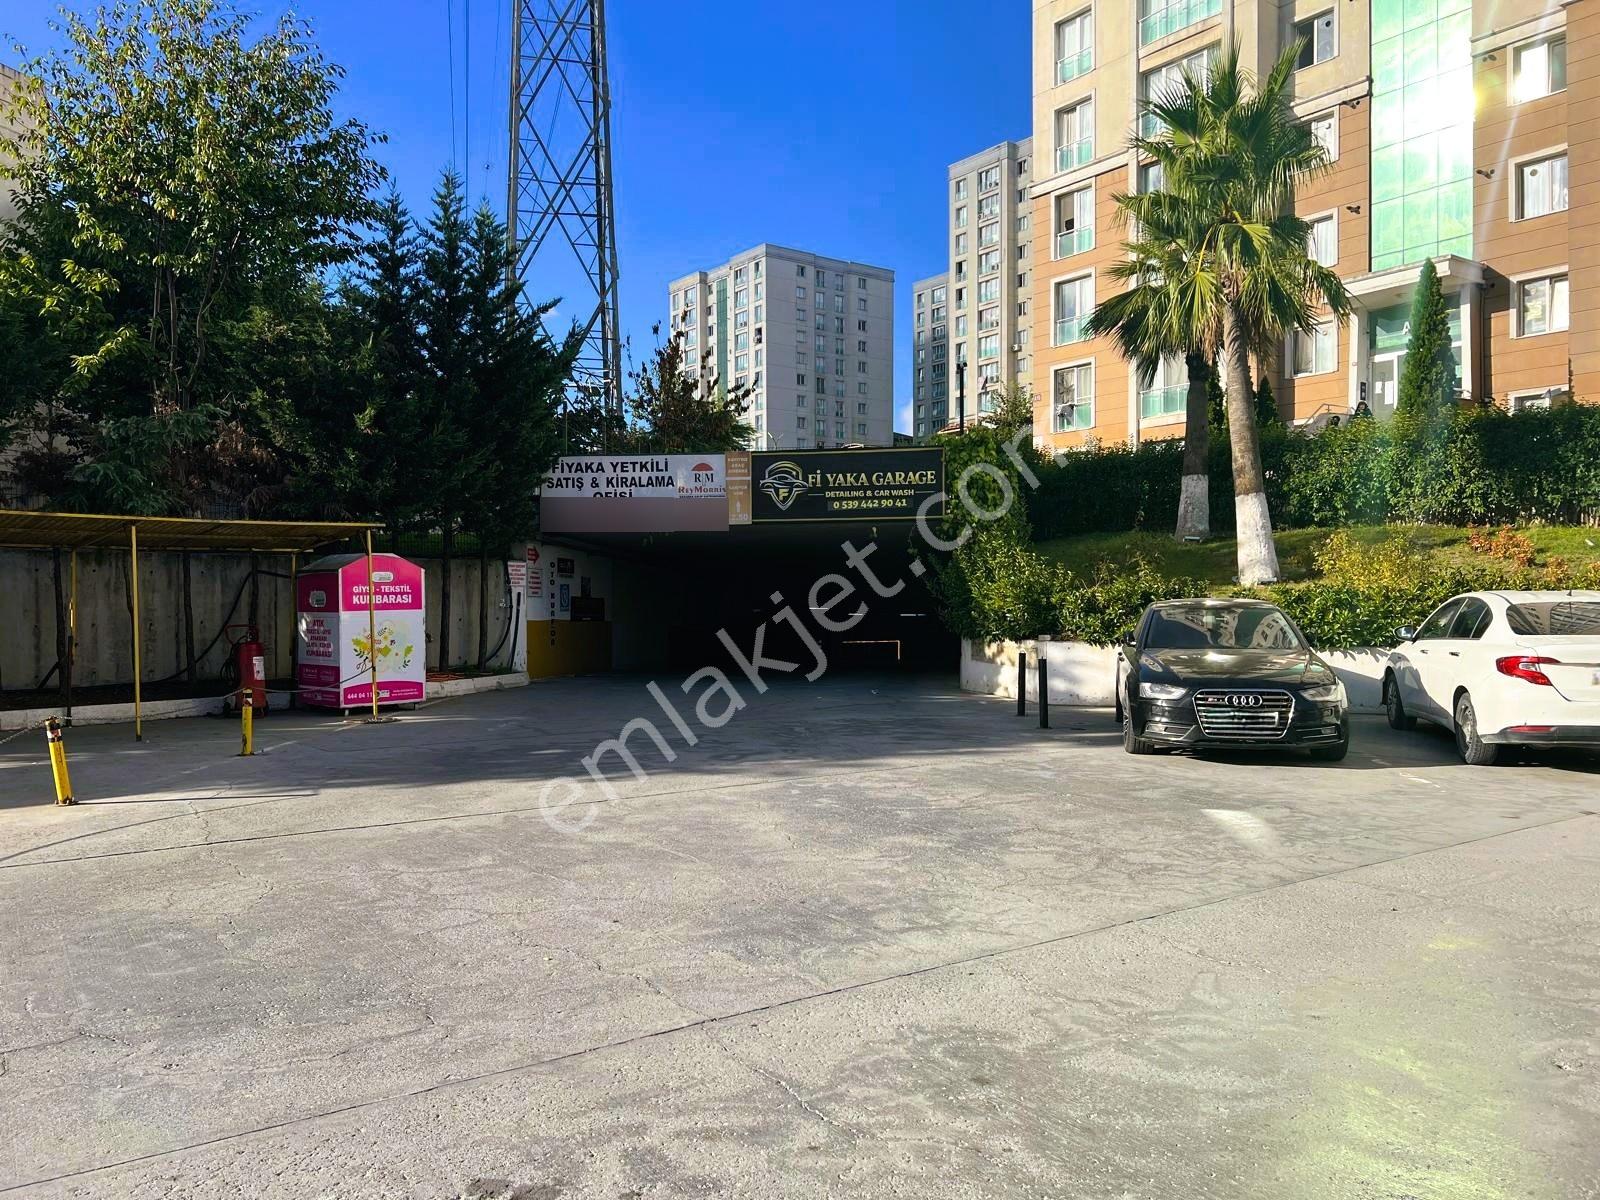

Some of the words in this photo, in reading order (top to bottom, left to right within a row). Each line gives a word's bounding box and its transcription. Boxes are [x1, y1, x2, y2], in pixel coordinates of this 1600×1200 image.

[552, 460, 605, 473] FİYAKA
[610, 457, 669, 473] YETKİLİ
[547, 477, 584, 491] SATIŞ
[590, 477, 599, 488] &
[606, 474, 675, 488] KİRALAMA
[826, 472, 869, 487] YAKA
[872, 470, 936, 486] GARAGE
[833, 501, 840, 509] 0
[842, 501, 859, 510] 539
[861, 500, 879, 509] 442
[881, 500, 893, 508] 90
[895, 499, 907, 507] 41
[381, 583, 412, 593] TEKSTİL
